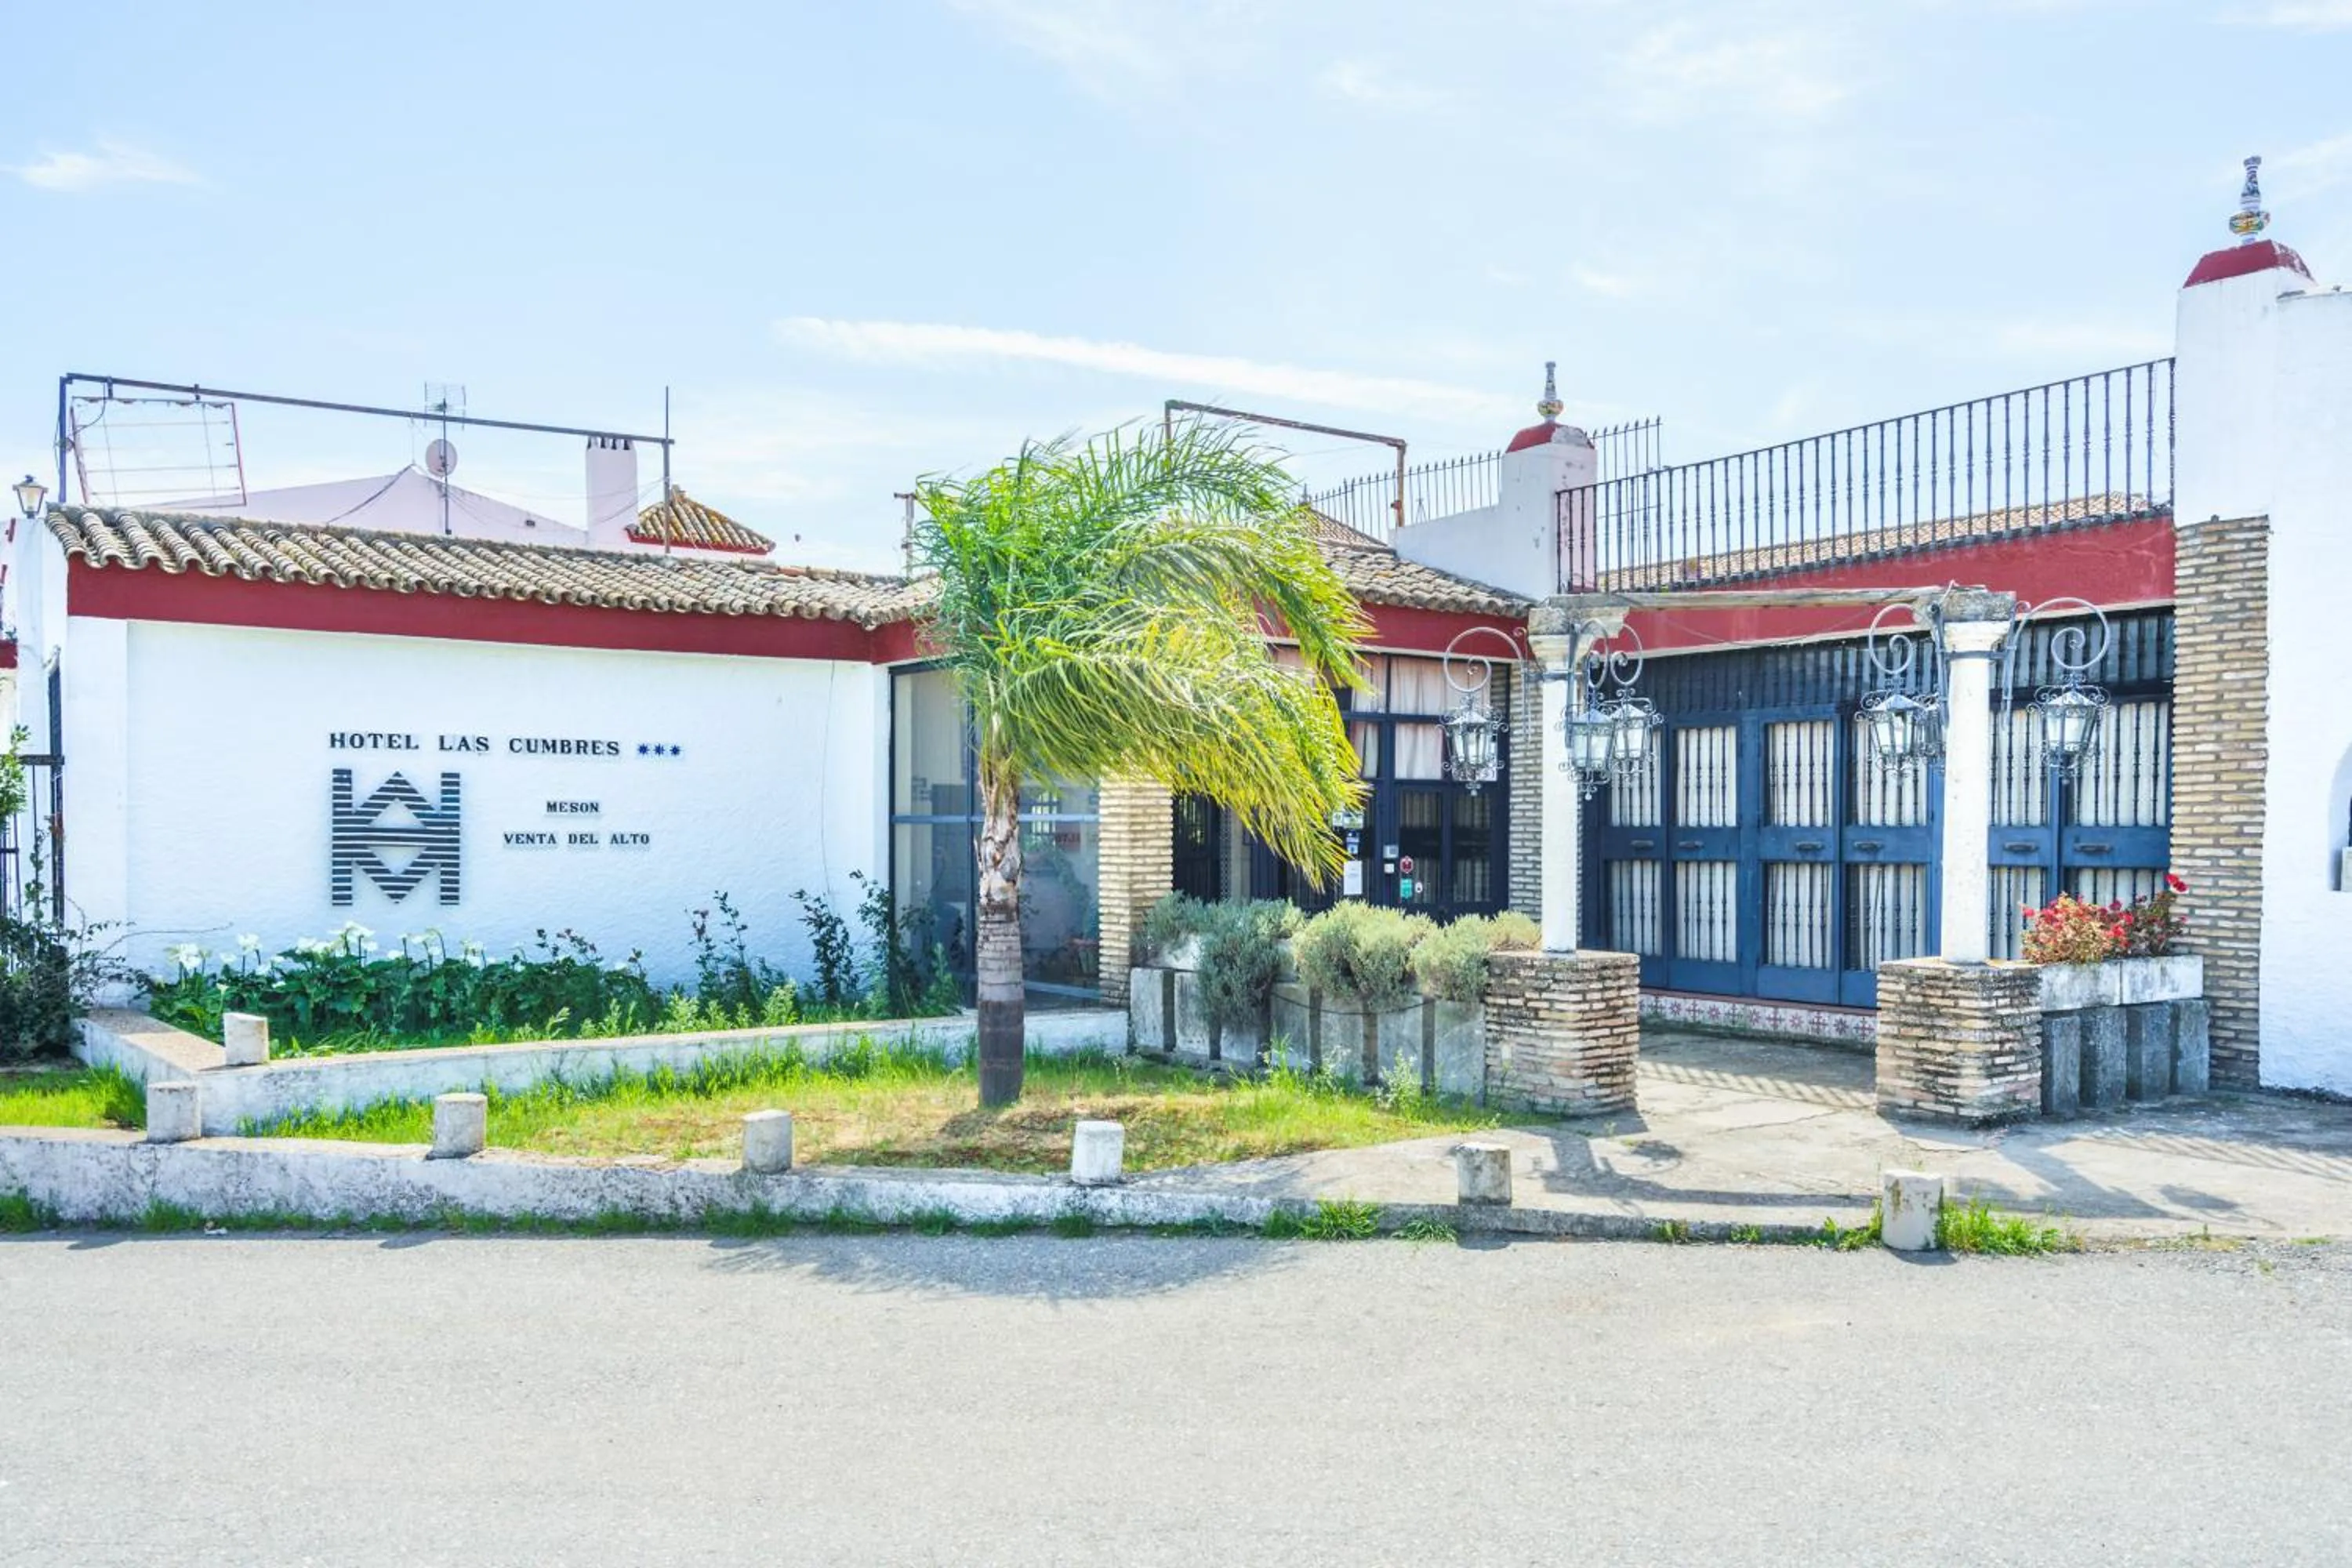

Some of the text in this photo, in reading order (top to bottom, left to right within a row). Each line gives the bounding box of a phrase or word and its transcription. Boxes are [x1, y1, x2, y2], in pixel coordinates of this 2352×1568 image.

[329, 732, 621, 757] HOTEL LAS CUMBRES
[546, 801, 600, 813] MESON
[503, 833, 651, 845] VENTA DEL ALTO
